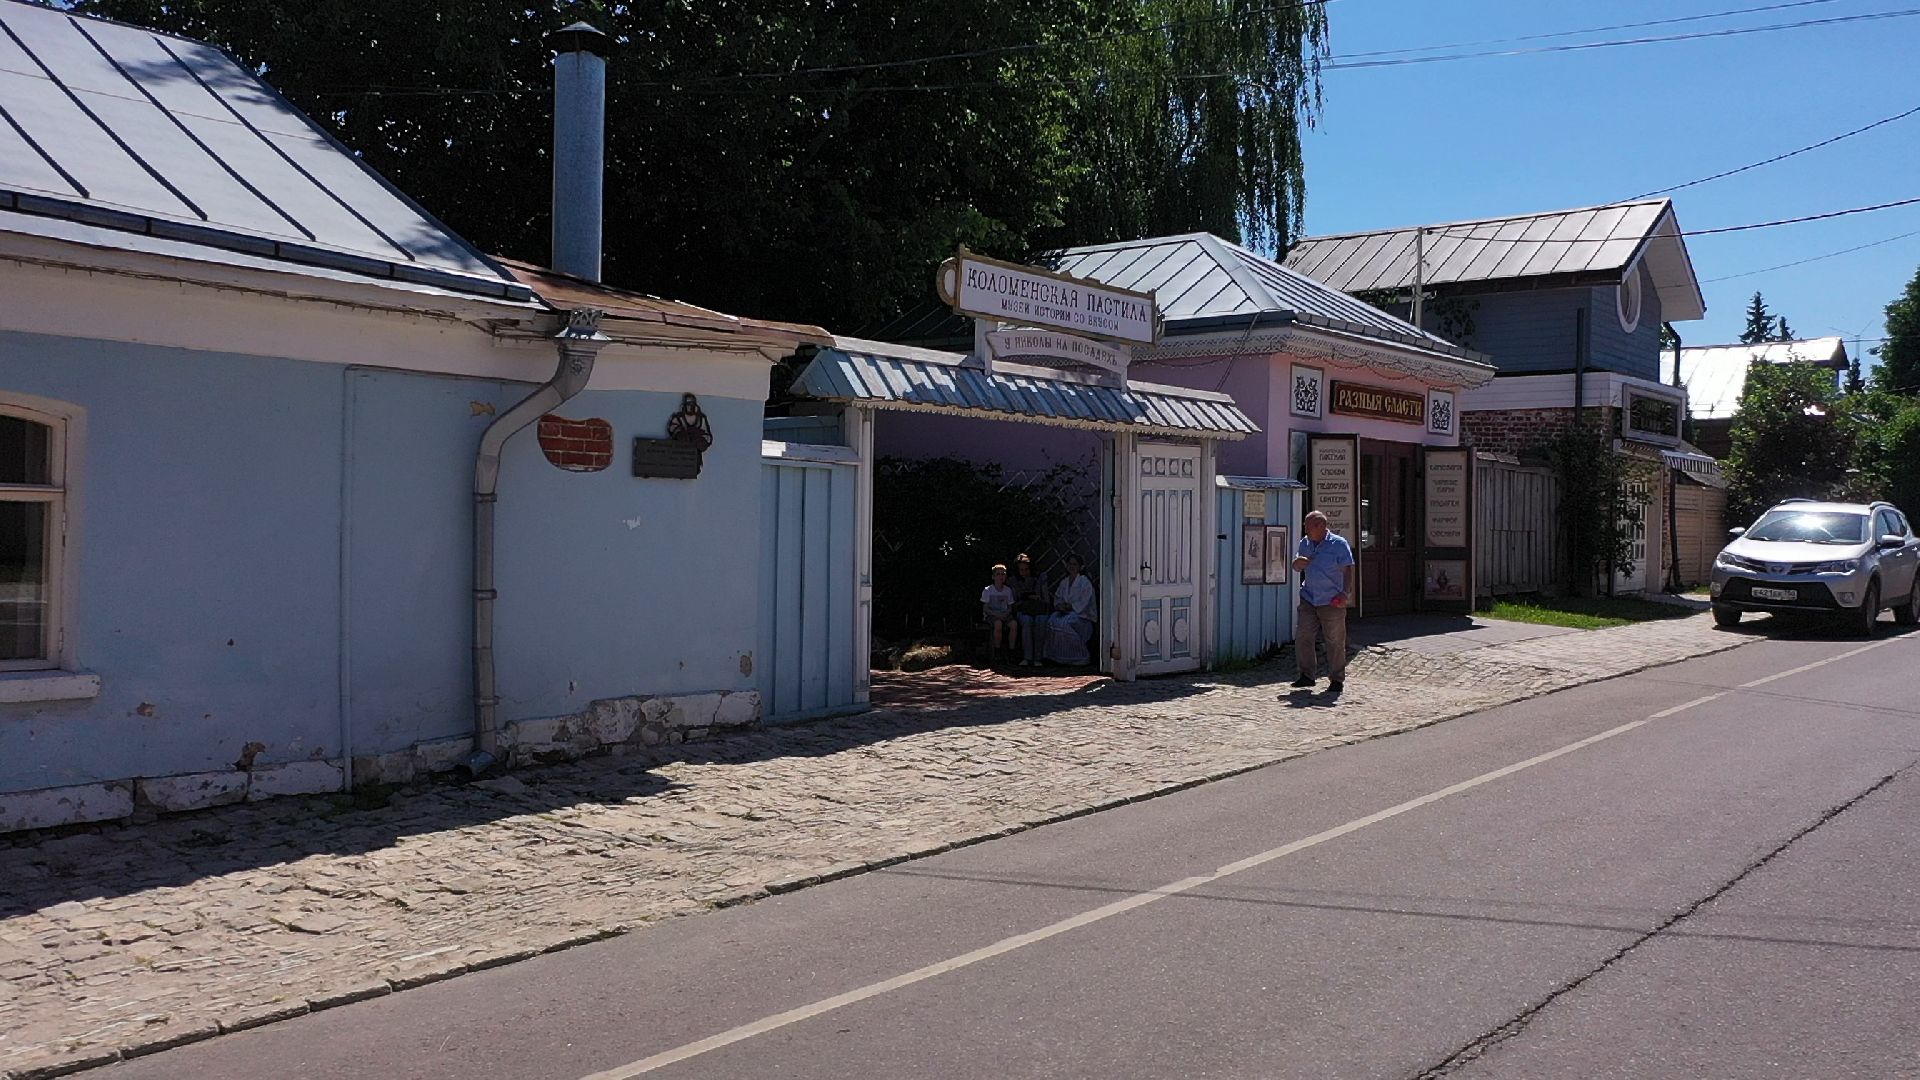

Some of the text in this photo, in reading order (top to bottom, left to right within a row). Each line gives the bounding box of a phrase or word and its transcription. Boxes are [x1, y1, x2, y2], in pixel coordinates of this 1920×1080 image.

[966, 267, 1148, 323] КОЛОМЕНСКАЯ ПАСТИЛА
[1074, 312, 1085, 324] СО
[1004, 337, 1011, 350] У
[1056, 338, 1068, 351] НА
[1338, 389, 1422, 418] РАЗНЫЯ СЛАСТИ
